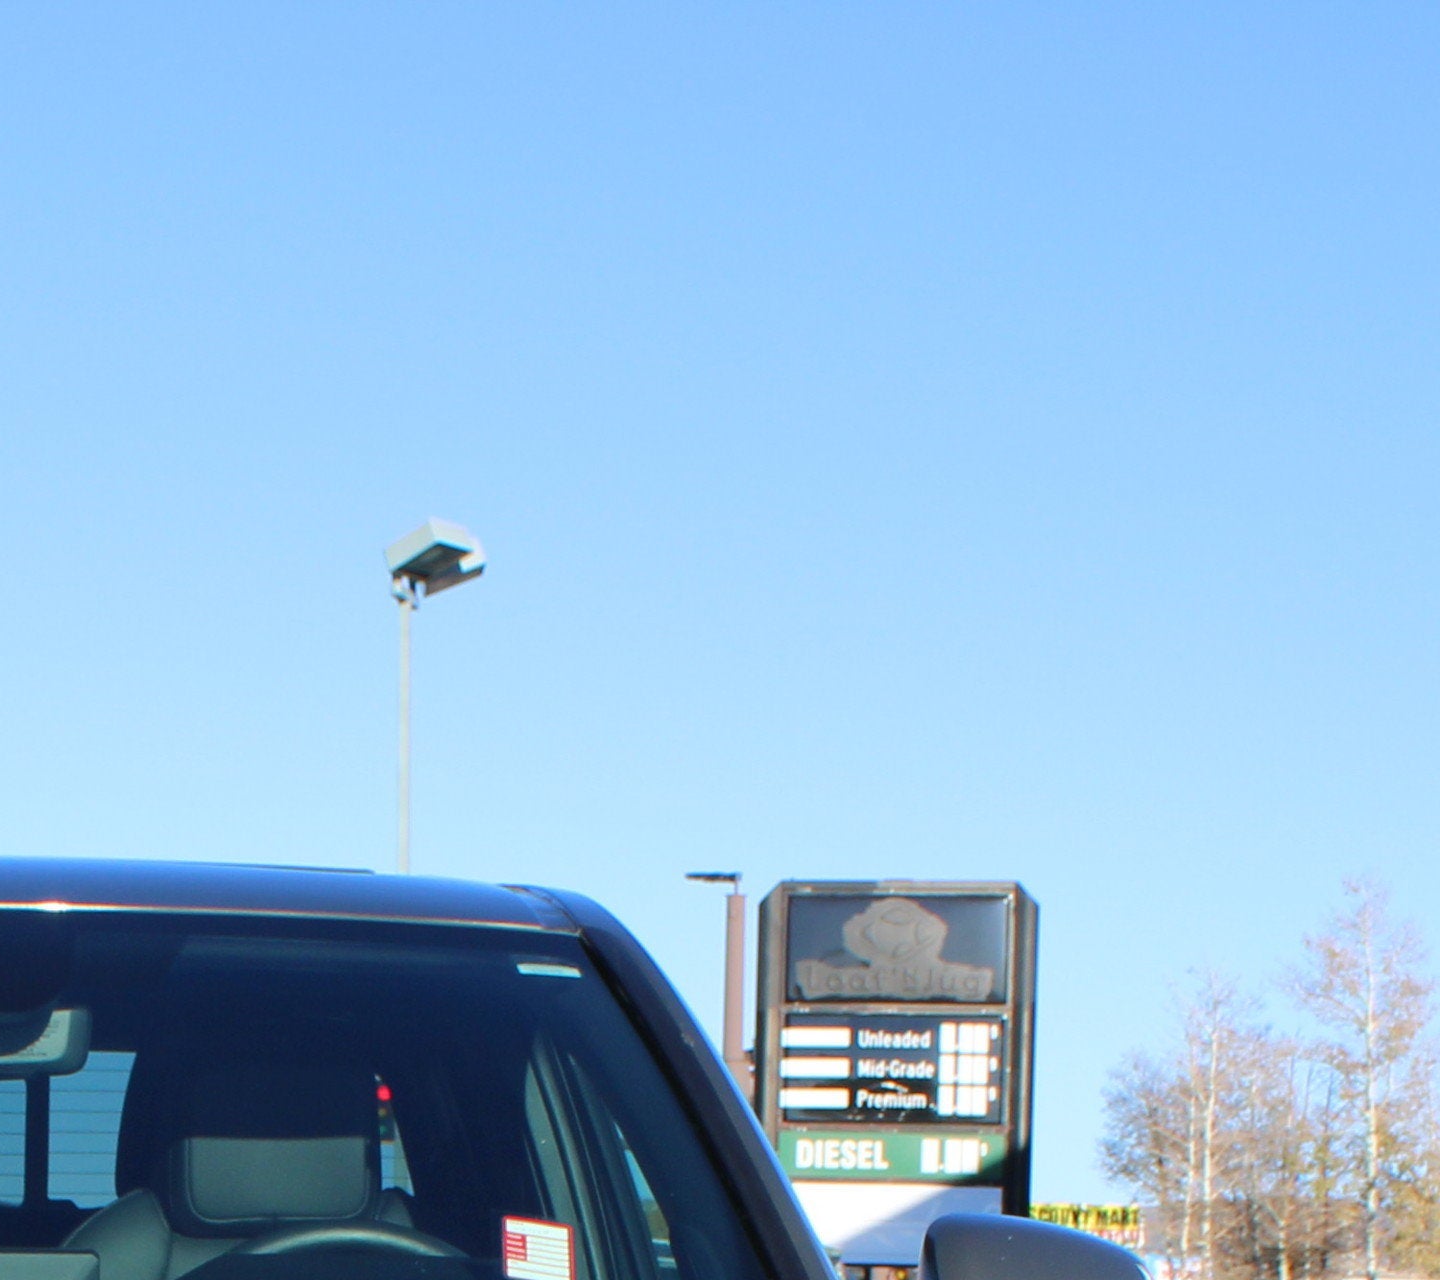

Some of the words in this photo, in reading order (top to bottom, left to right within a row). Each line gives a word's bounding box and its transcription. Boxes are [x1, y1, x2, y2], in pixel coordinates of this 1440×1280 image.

[857, 1029, 931, 1049] Unleaded
[856, 1059, 935, 1079] Mid-Grade
[855, 1089, 927, 1109] Premium
[795, 1139, 889, 1170] DIESEL
